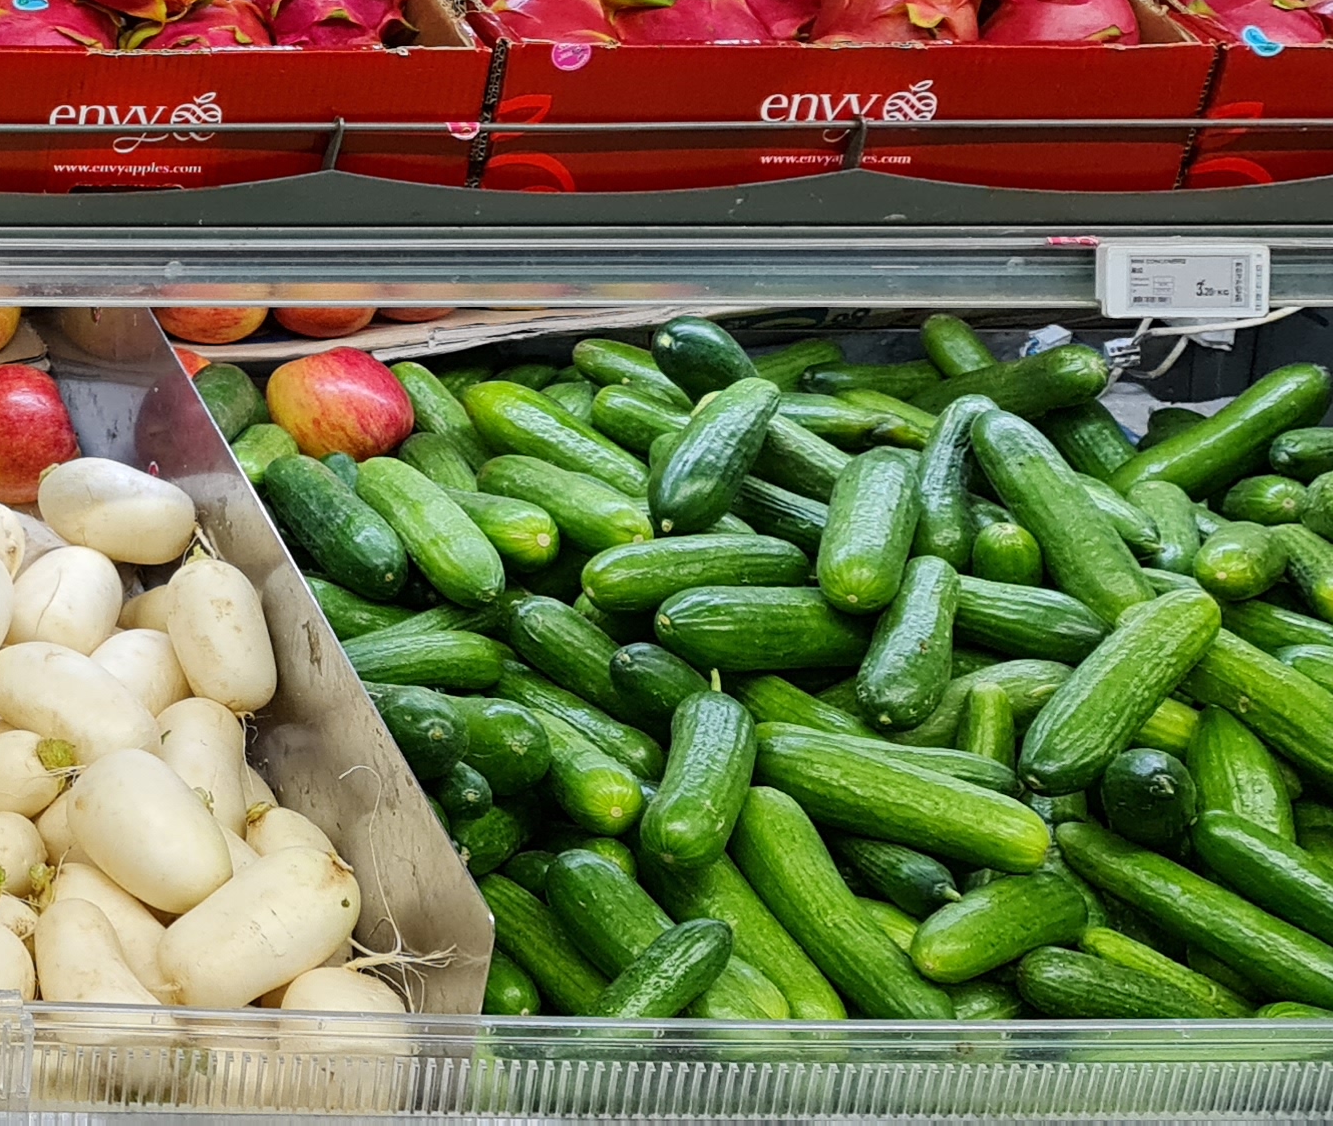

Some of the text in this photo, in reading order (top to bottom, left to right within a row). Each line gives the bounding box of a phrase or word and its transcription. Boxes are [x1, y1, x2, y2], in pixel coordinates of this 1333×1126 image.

[49, 105, 169, 153] envy
[760, 93, 883, 143] envy
[53, 162, 202, 176] www.envyapples.com
